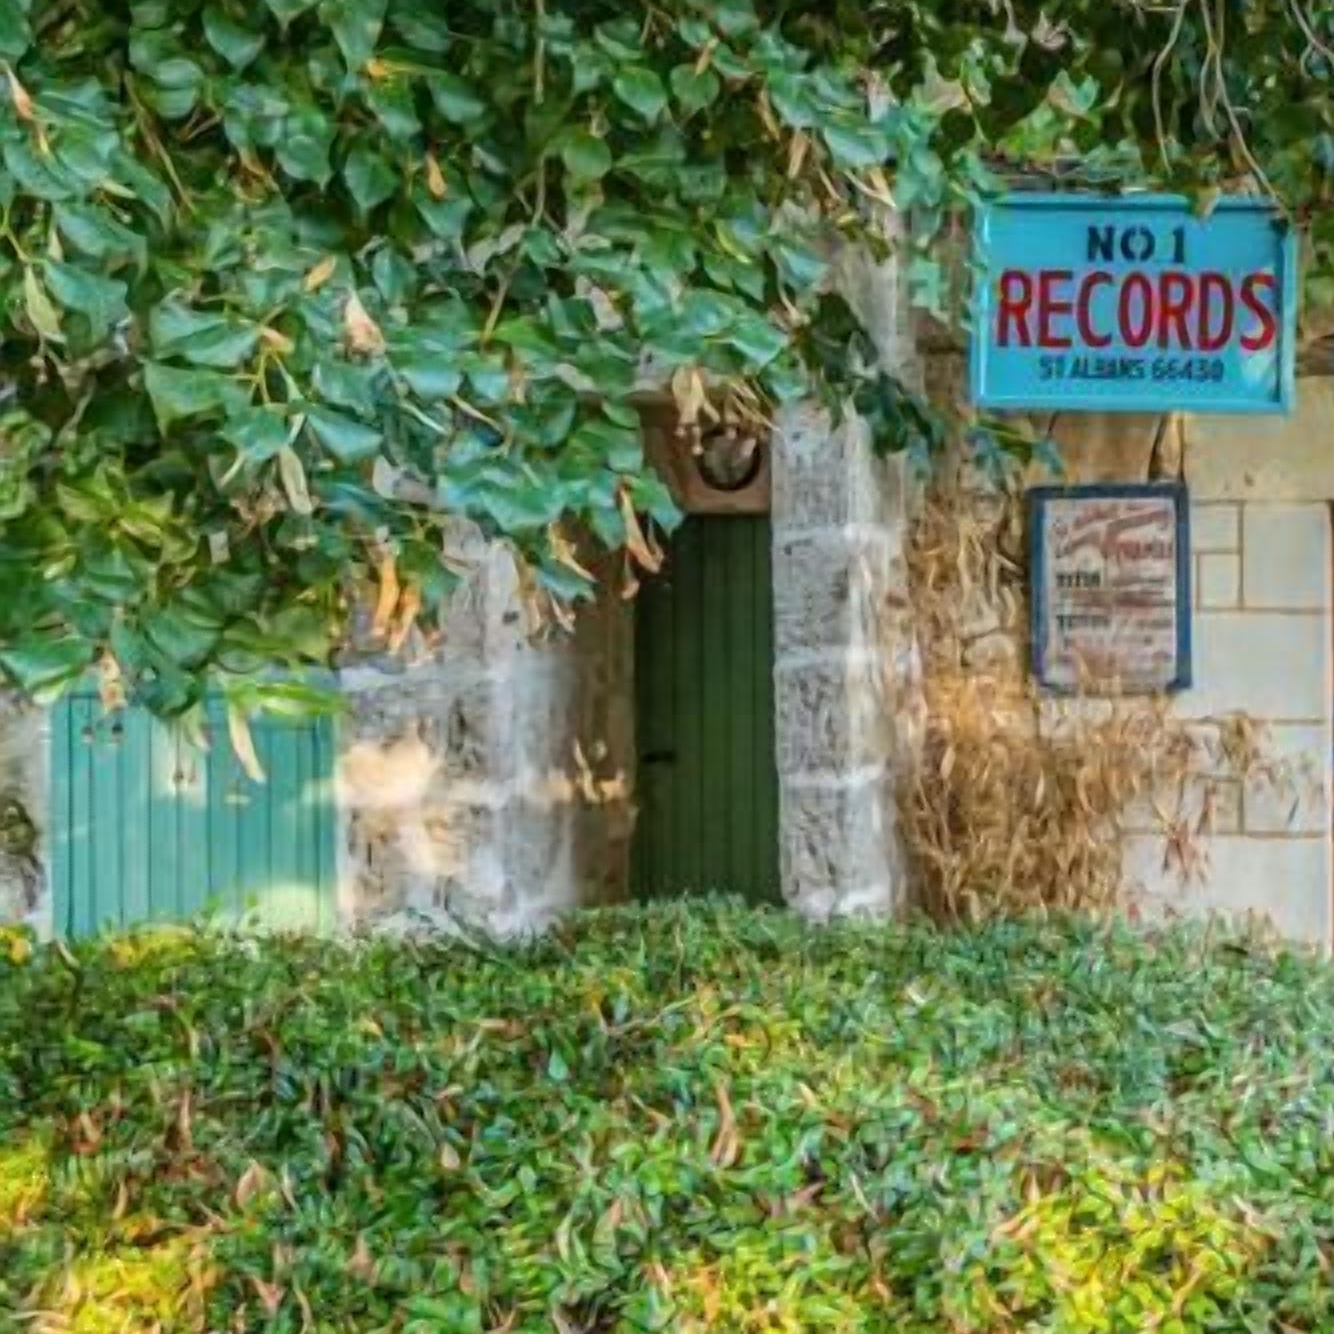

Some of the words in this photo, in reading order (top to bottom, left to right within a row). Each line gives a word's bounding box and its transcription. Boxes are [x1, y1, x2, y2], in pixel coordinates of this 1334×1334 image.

[1087, 226, 1156, 262] NO
[1171, 226, 1186, 263] 1
[996, 269, 1277, 351] RECORDS
[1039, 356, 1064, 380] ST
[1070, 356, 1145, 379] ALBANS
